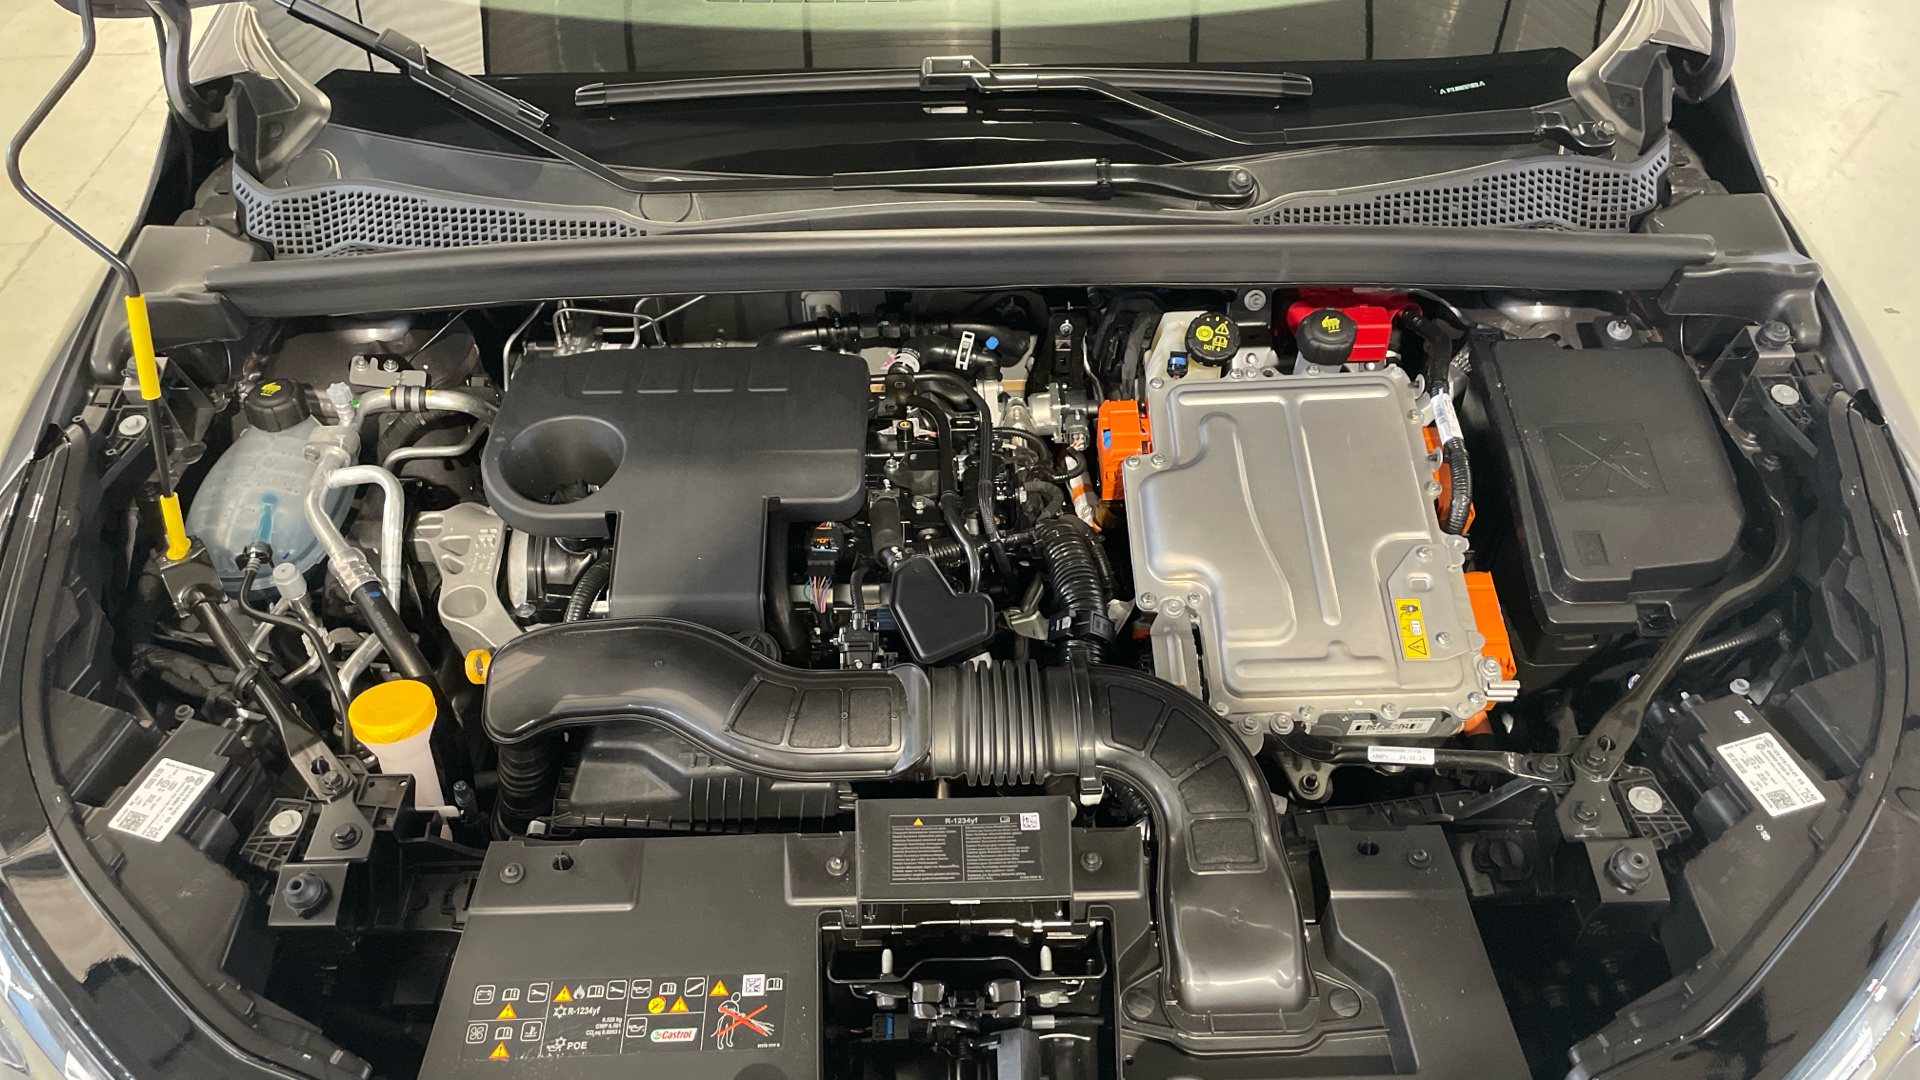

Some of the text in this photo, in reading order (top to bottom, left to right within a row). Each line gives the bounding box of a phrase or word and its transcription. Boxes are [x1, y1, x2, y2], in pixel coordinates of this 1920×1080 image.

[945, 816, 978, 825] R-1234yf
[567, 1006, 601, 1016] R-1234yf
[661, 1030, 693, 1040] Castrol
[566, 1041, 588, 1050] POE
